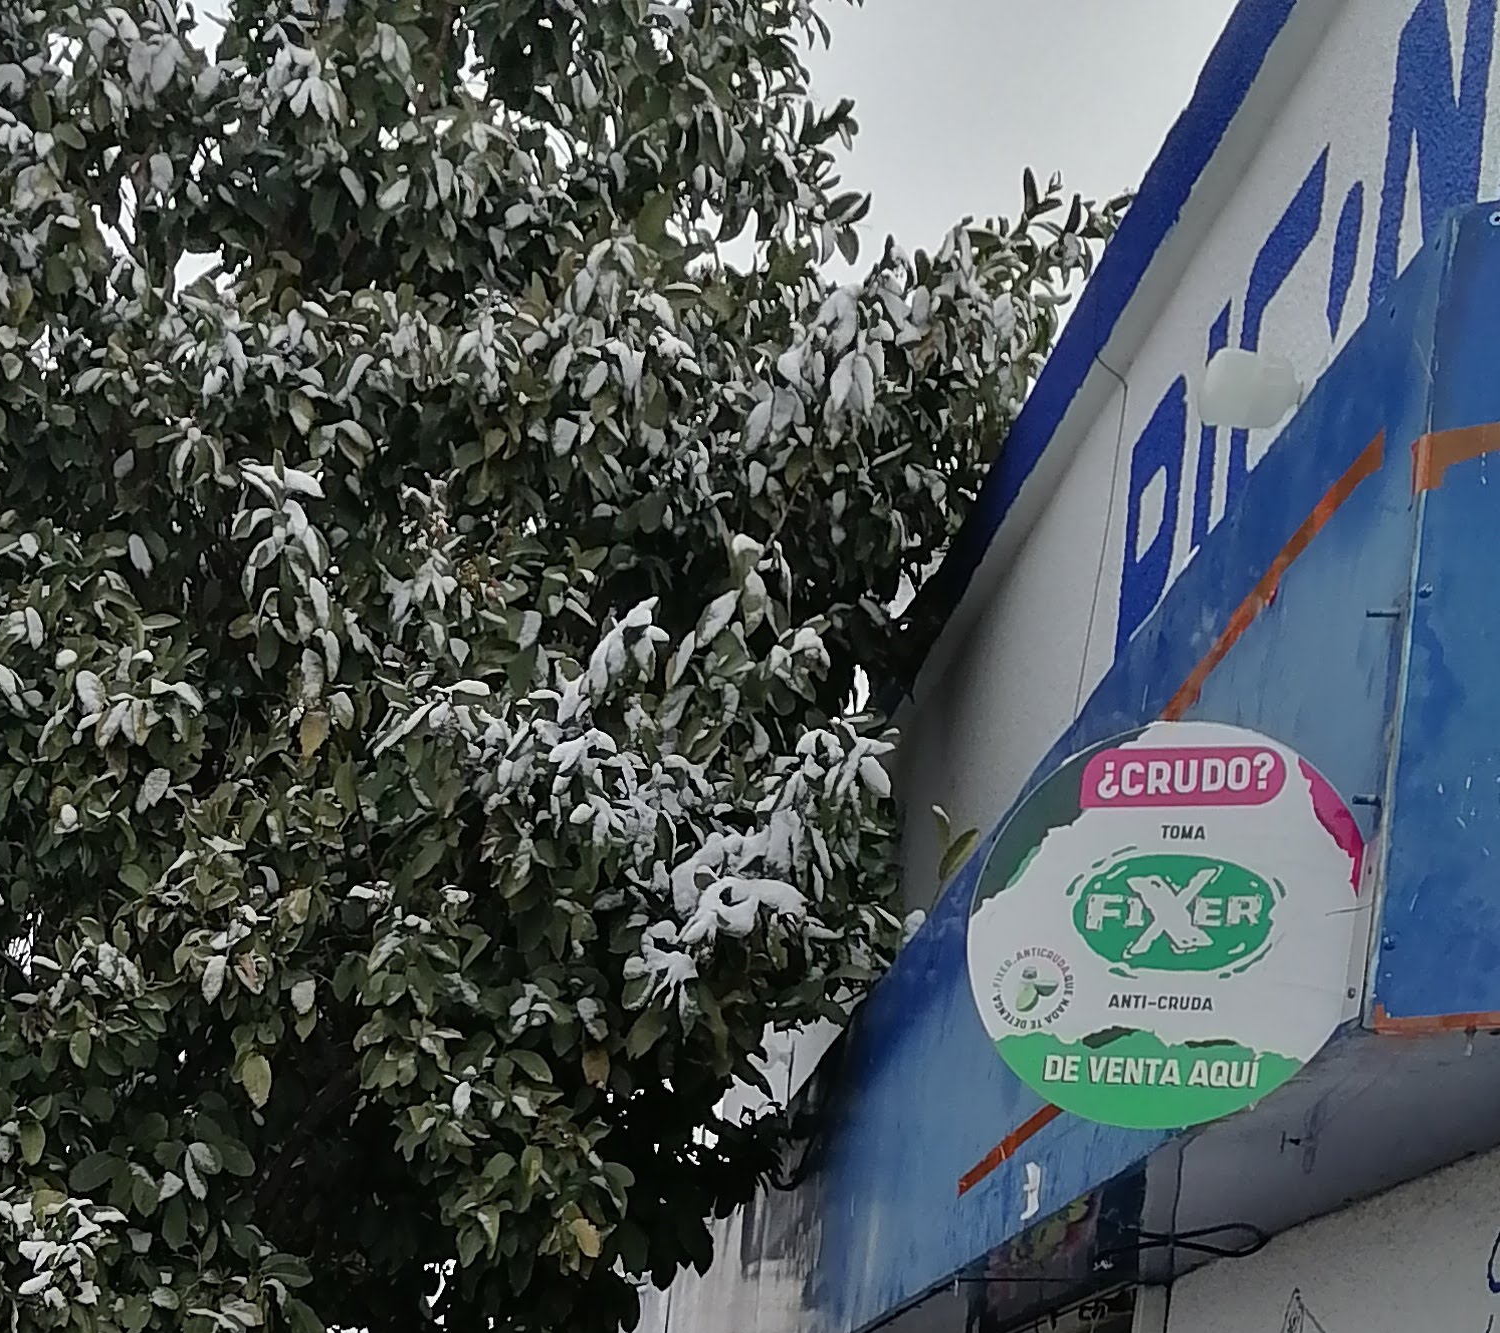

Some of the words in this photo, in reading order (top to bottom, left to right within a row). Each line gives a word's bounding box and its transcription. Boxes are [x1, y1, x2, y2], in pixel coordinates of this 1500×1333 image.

[1097, 752, 1275, 799] ¿CRUDO?
[1161, 825, 1206, 840] TOMA
[1085, 867, 1264, 956] FIXER
[1045, 998, 1070, 1024] NADA
[1108, 995, 1214, 1012] ANTI-CRUDA
[1044, 1055, 1081, 1082] DE
[1089, 1056, 1181, 1086] VENTA
[1188, 1055, 1261, 1088] AQUÍ
